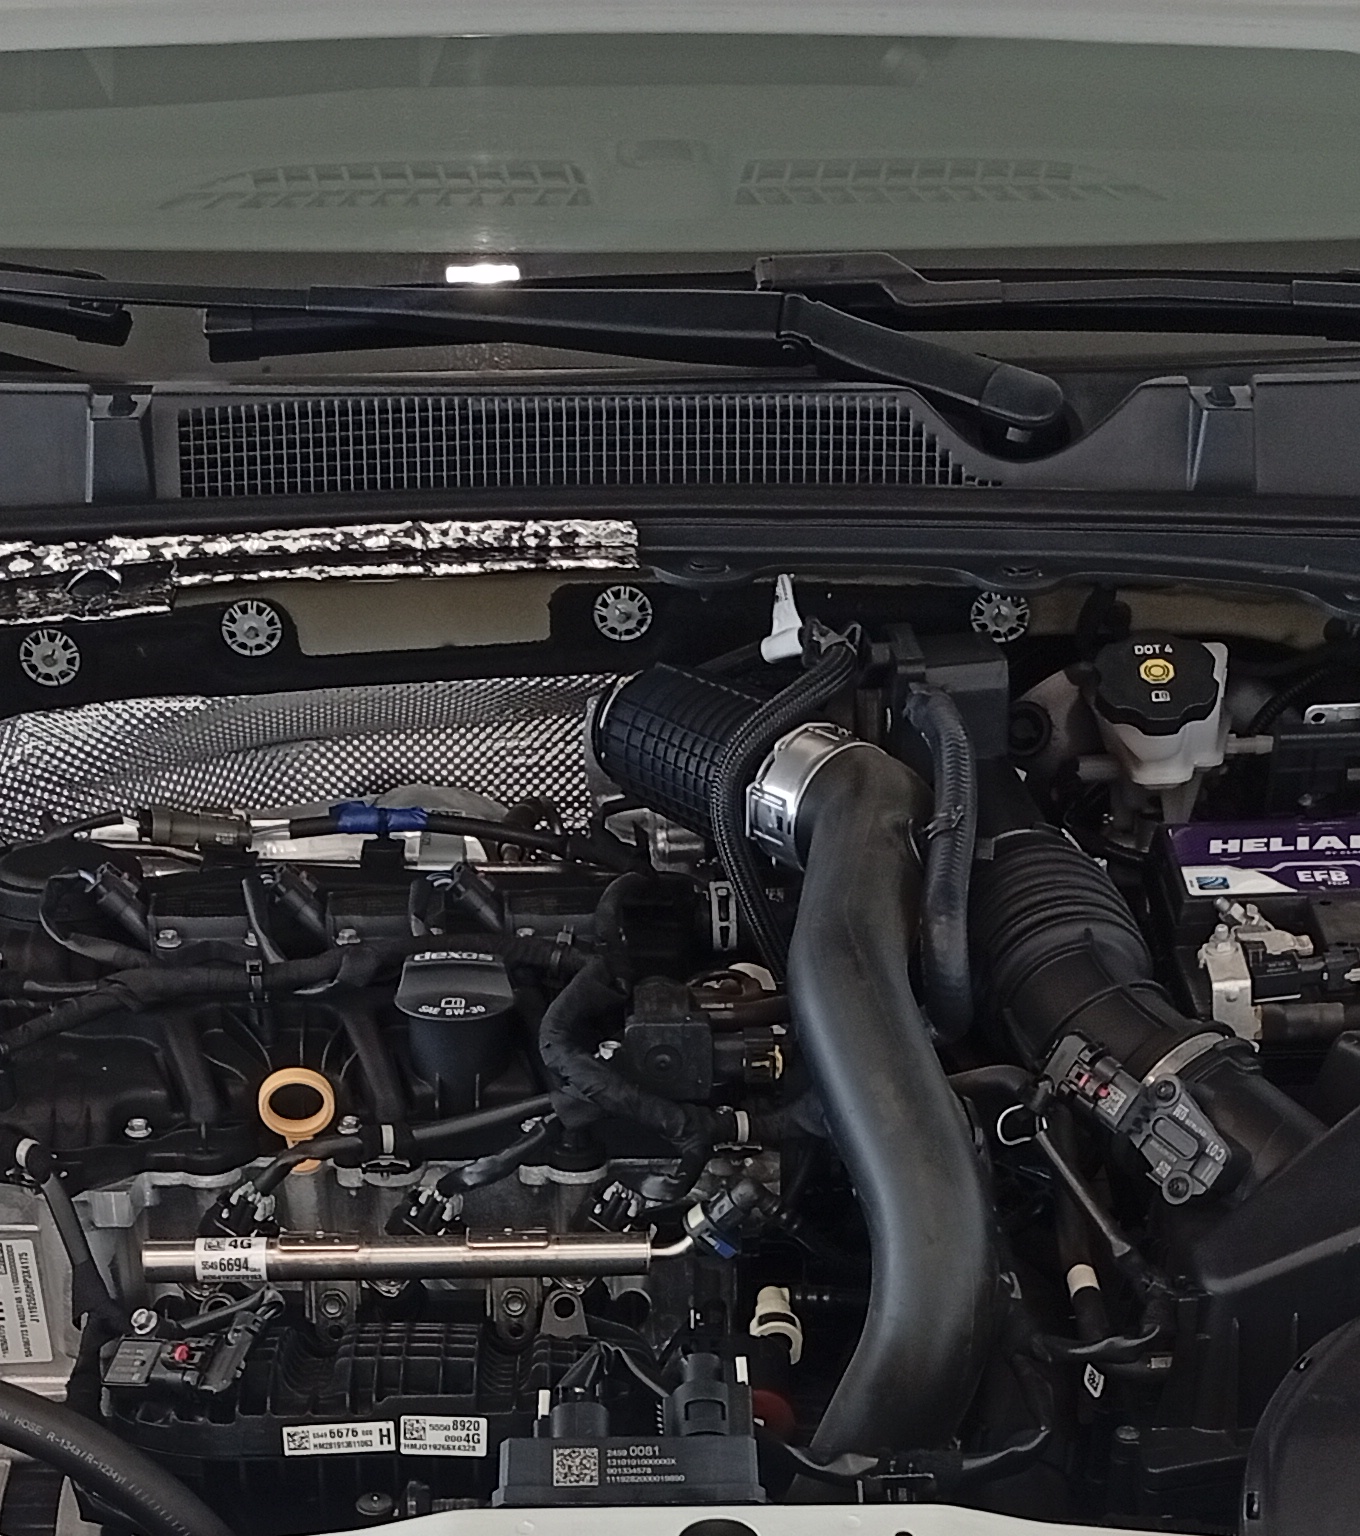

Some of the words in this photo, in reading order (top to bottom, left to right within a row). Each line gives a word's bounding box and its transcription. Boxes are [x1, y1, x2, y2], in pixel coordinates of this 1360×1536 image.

[1134, 644, 1161, 655] DOT
[1163, 643, 1173, 654] 4
[1296, 870, 1349, 883] EFB
[413, 951, 493, 961] dexos
[418, 1005, 442, 1015] SAE
[445, 1005, 486, 1016] 5W-30
[228, 1238, 252, 1249] 4G
[13, 1415, 43, 1436] HOSE
[329, 1428, 359, 1439] 6676
[378, 1428, 392, 1445] H
[629, 1446, 659, 1456] 0081
